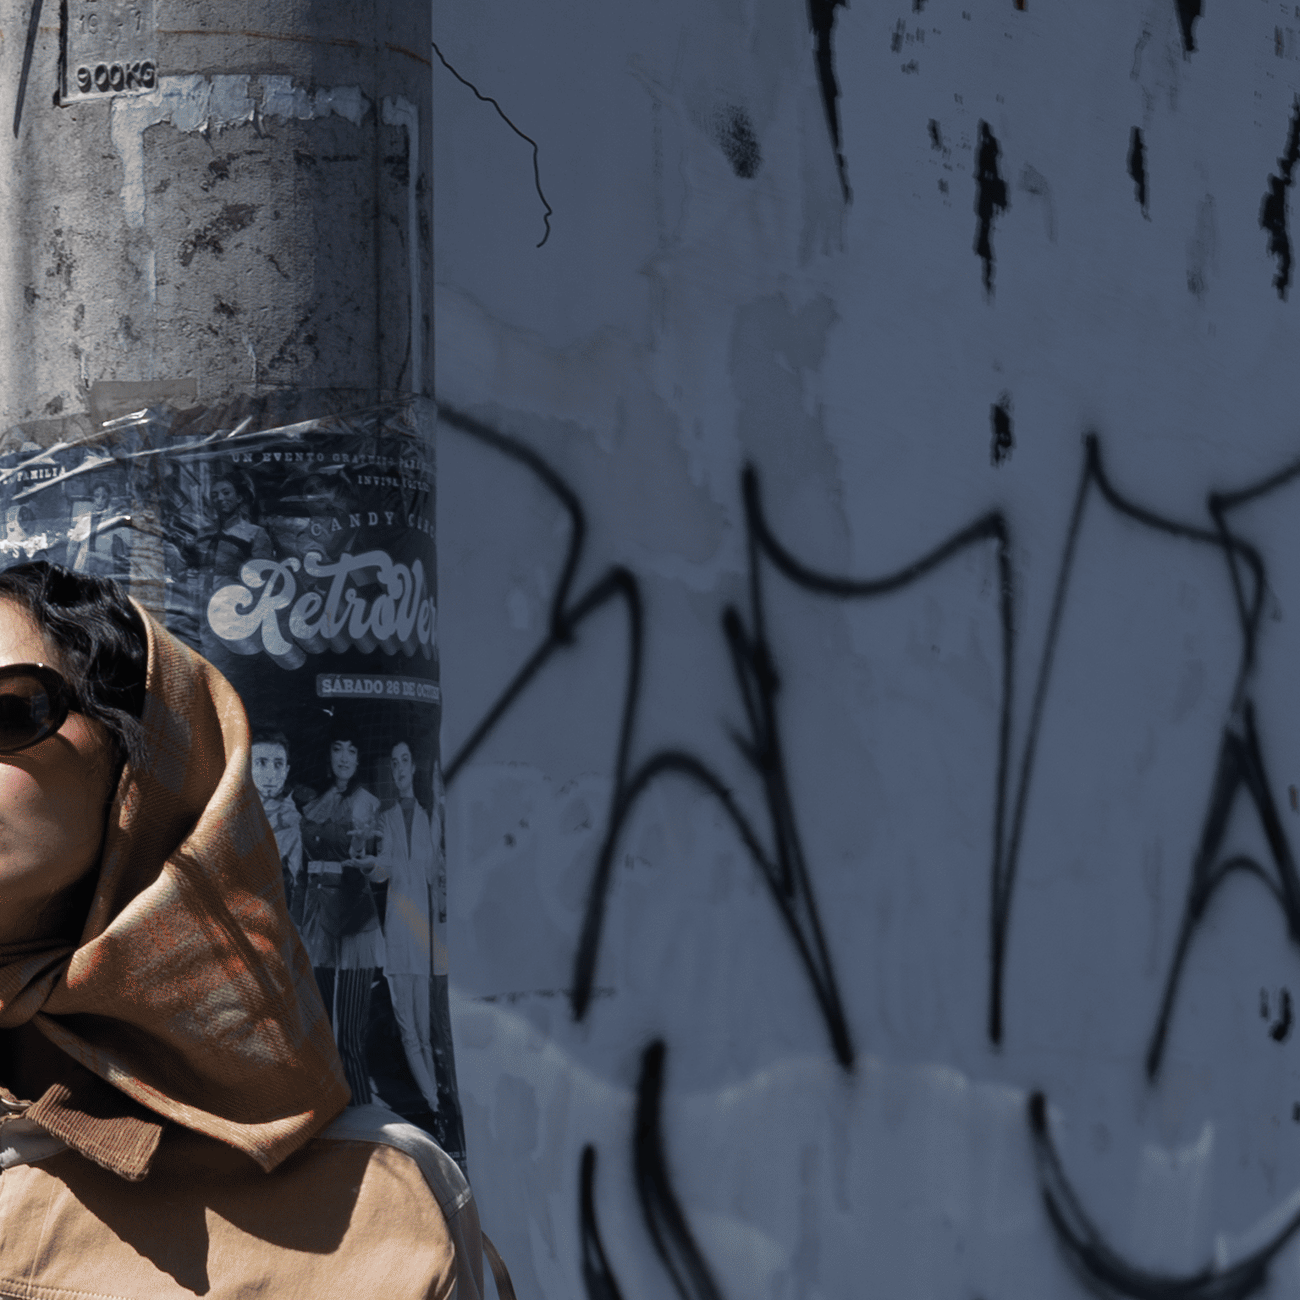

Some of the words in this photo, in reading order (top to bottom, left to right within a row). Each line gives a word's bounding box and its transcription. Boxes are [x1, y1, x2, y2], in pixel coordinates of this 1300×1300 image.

[77, 60, 156, 93] 900KG
[232, 452, 253, 463] UN
[262, 452, 325, 463] EVENTO
[310, 511, 395, 537] CANDY
[321, 675, 383, 694] SÁBADO
[386, 680, 400, 695] 26
[402, 681, 416, 697] DE
